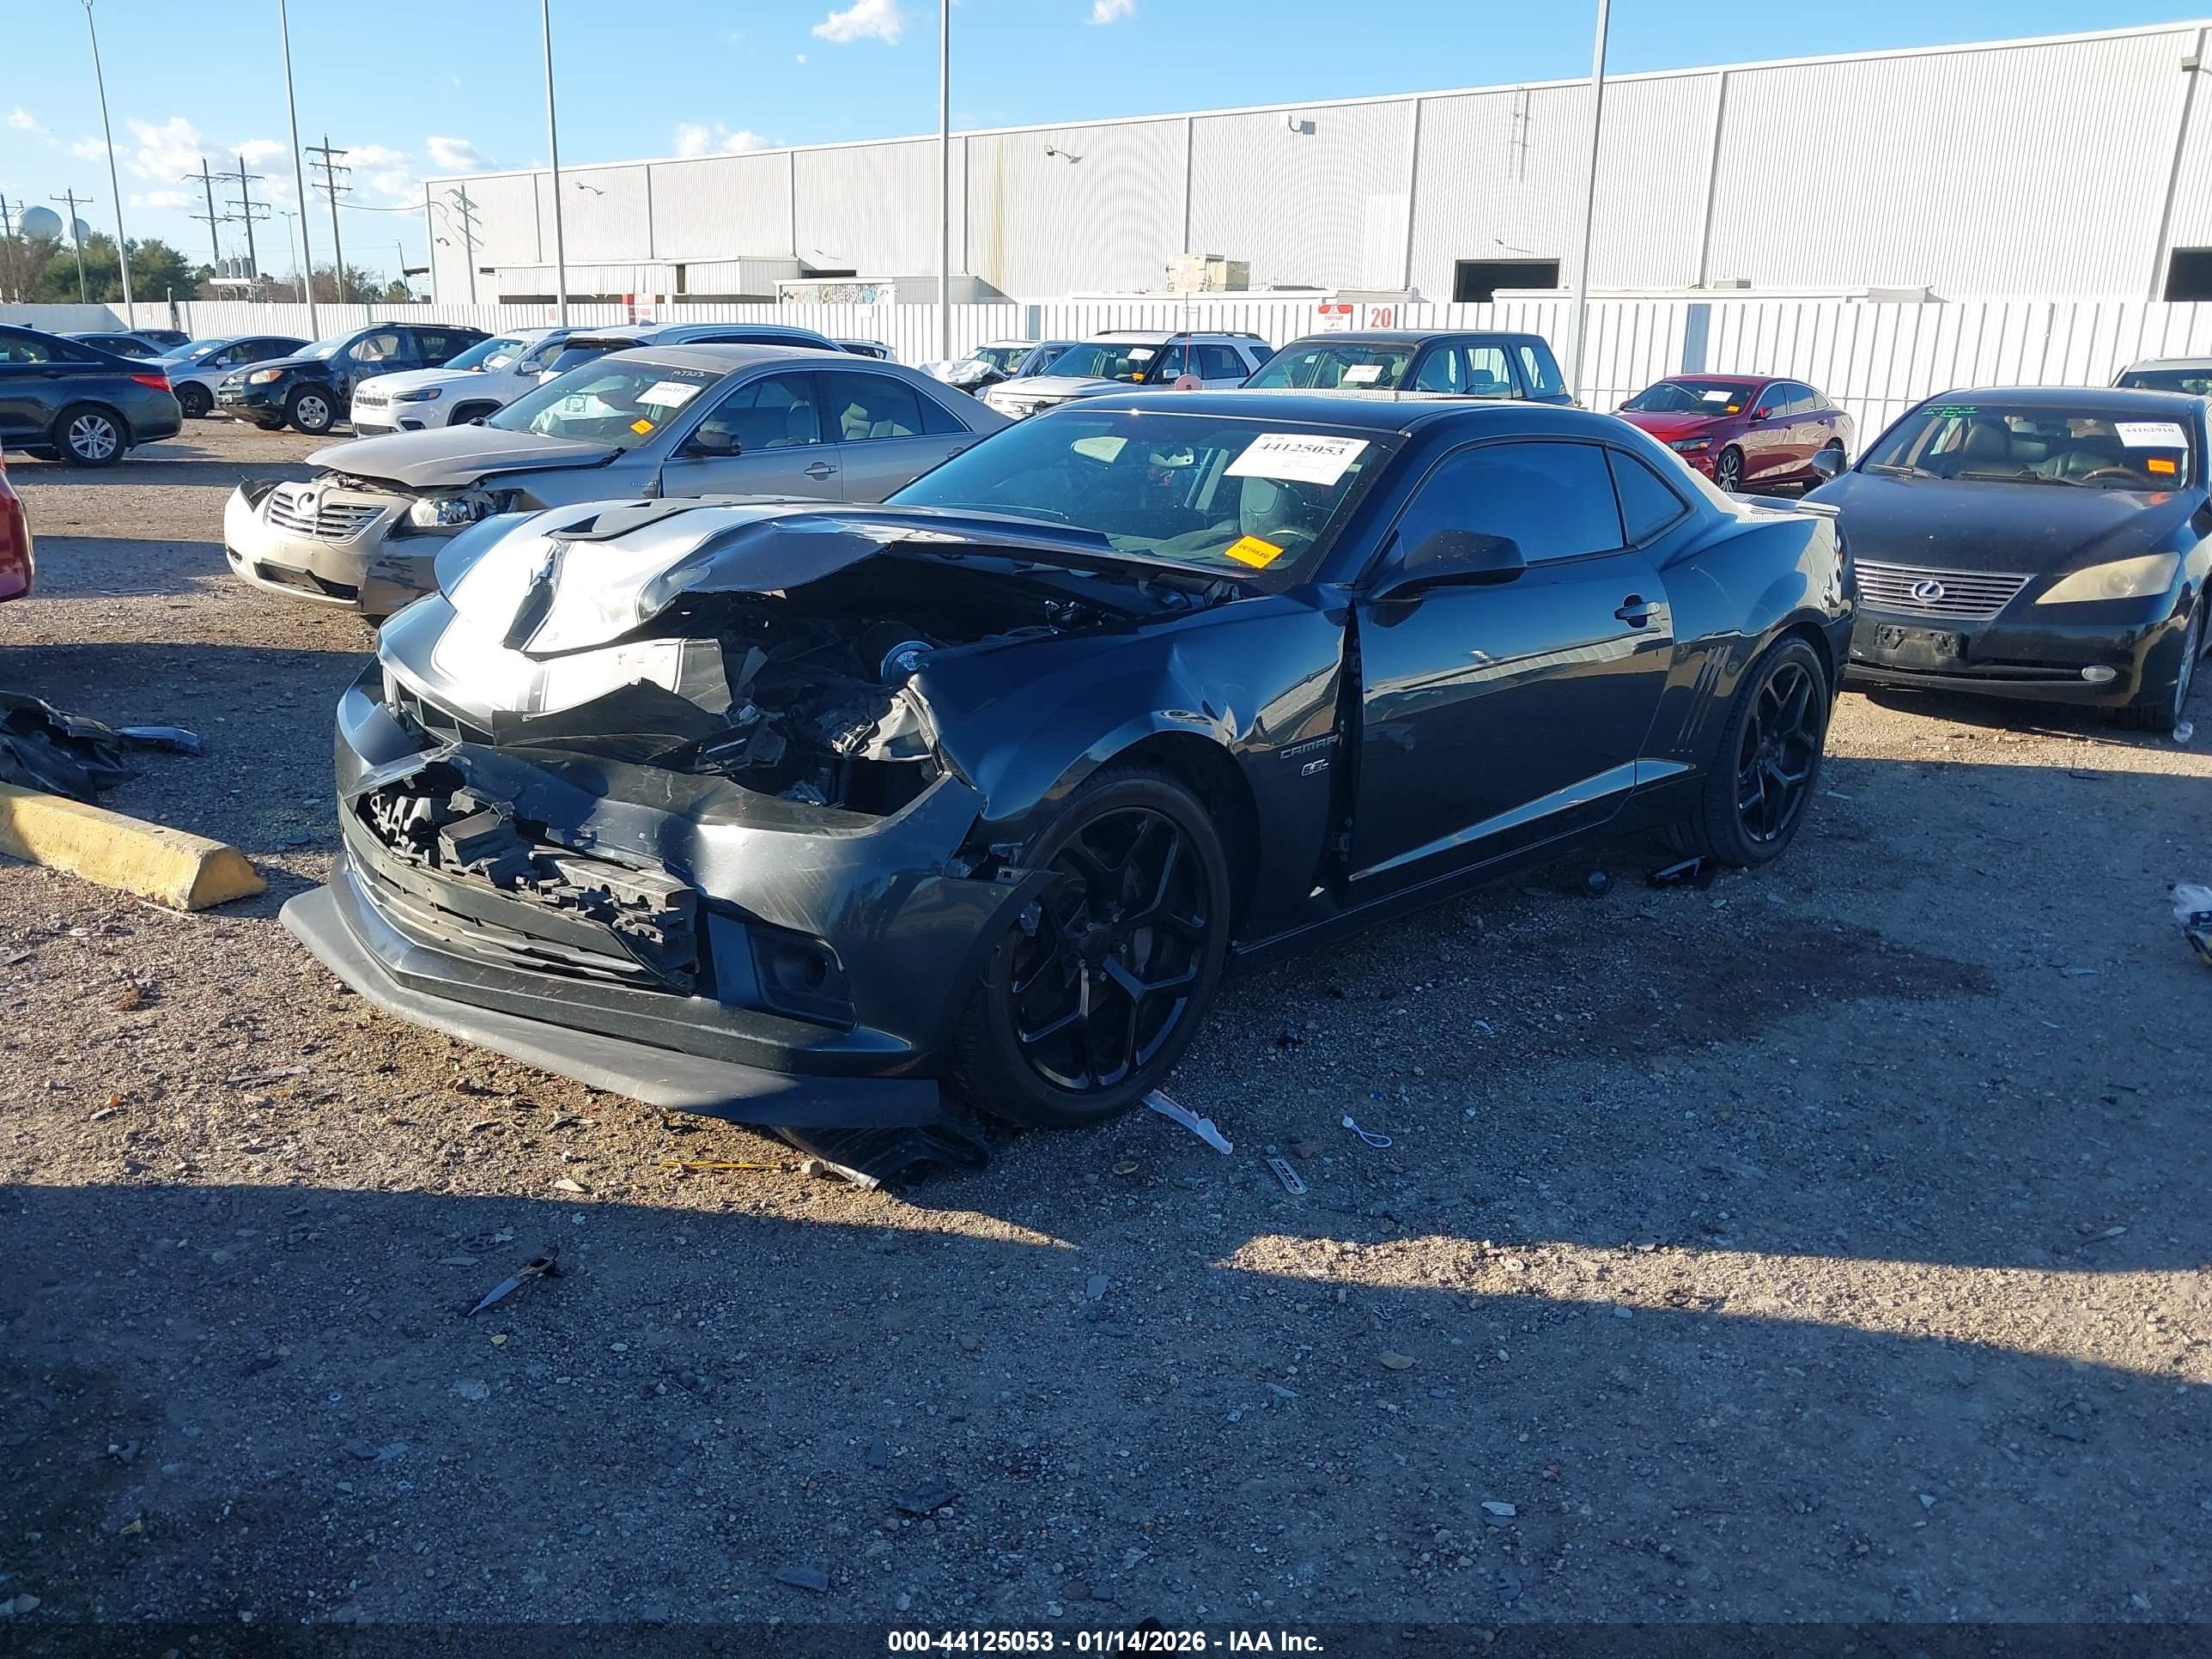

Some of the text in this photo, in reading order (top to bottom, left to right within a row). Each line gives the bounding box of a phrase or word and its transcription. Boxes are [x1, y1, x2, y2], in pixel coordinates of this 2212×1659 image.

[1370, 307, 1392, 328] 20
[1259, 442, 1346, 456] 44125053
[1238, 544, 1270, 559] DETAILED
